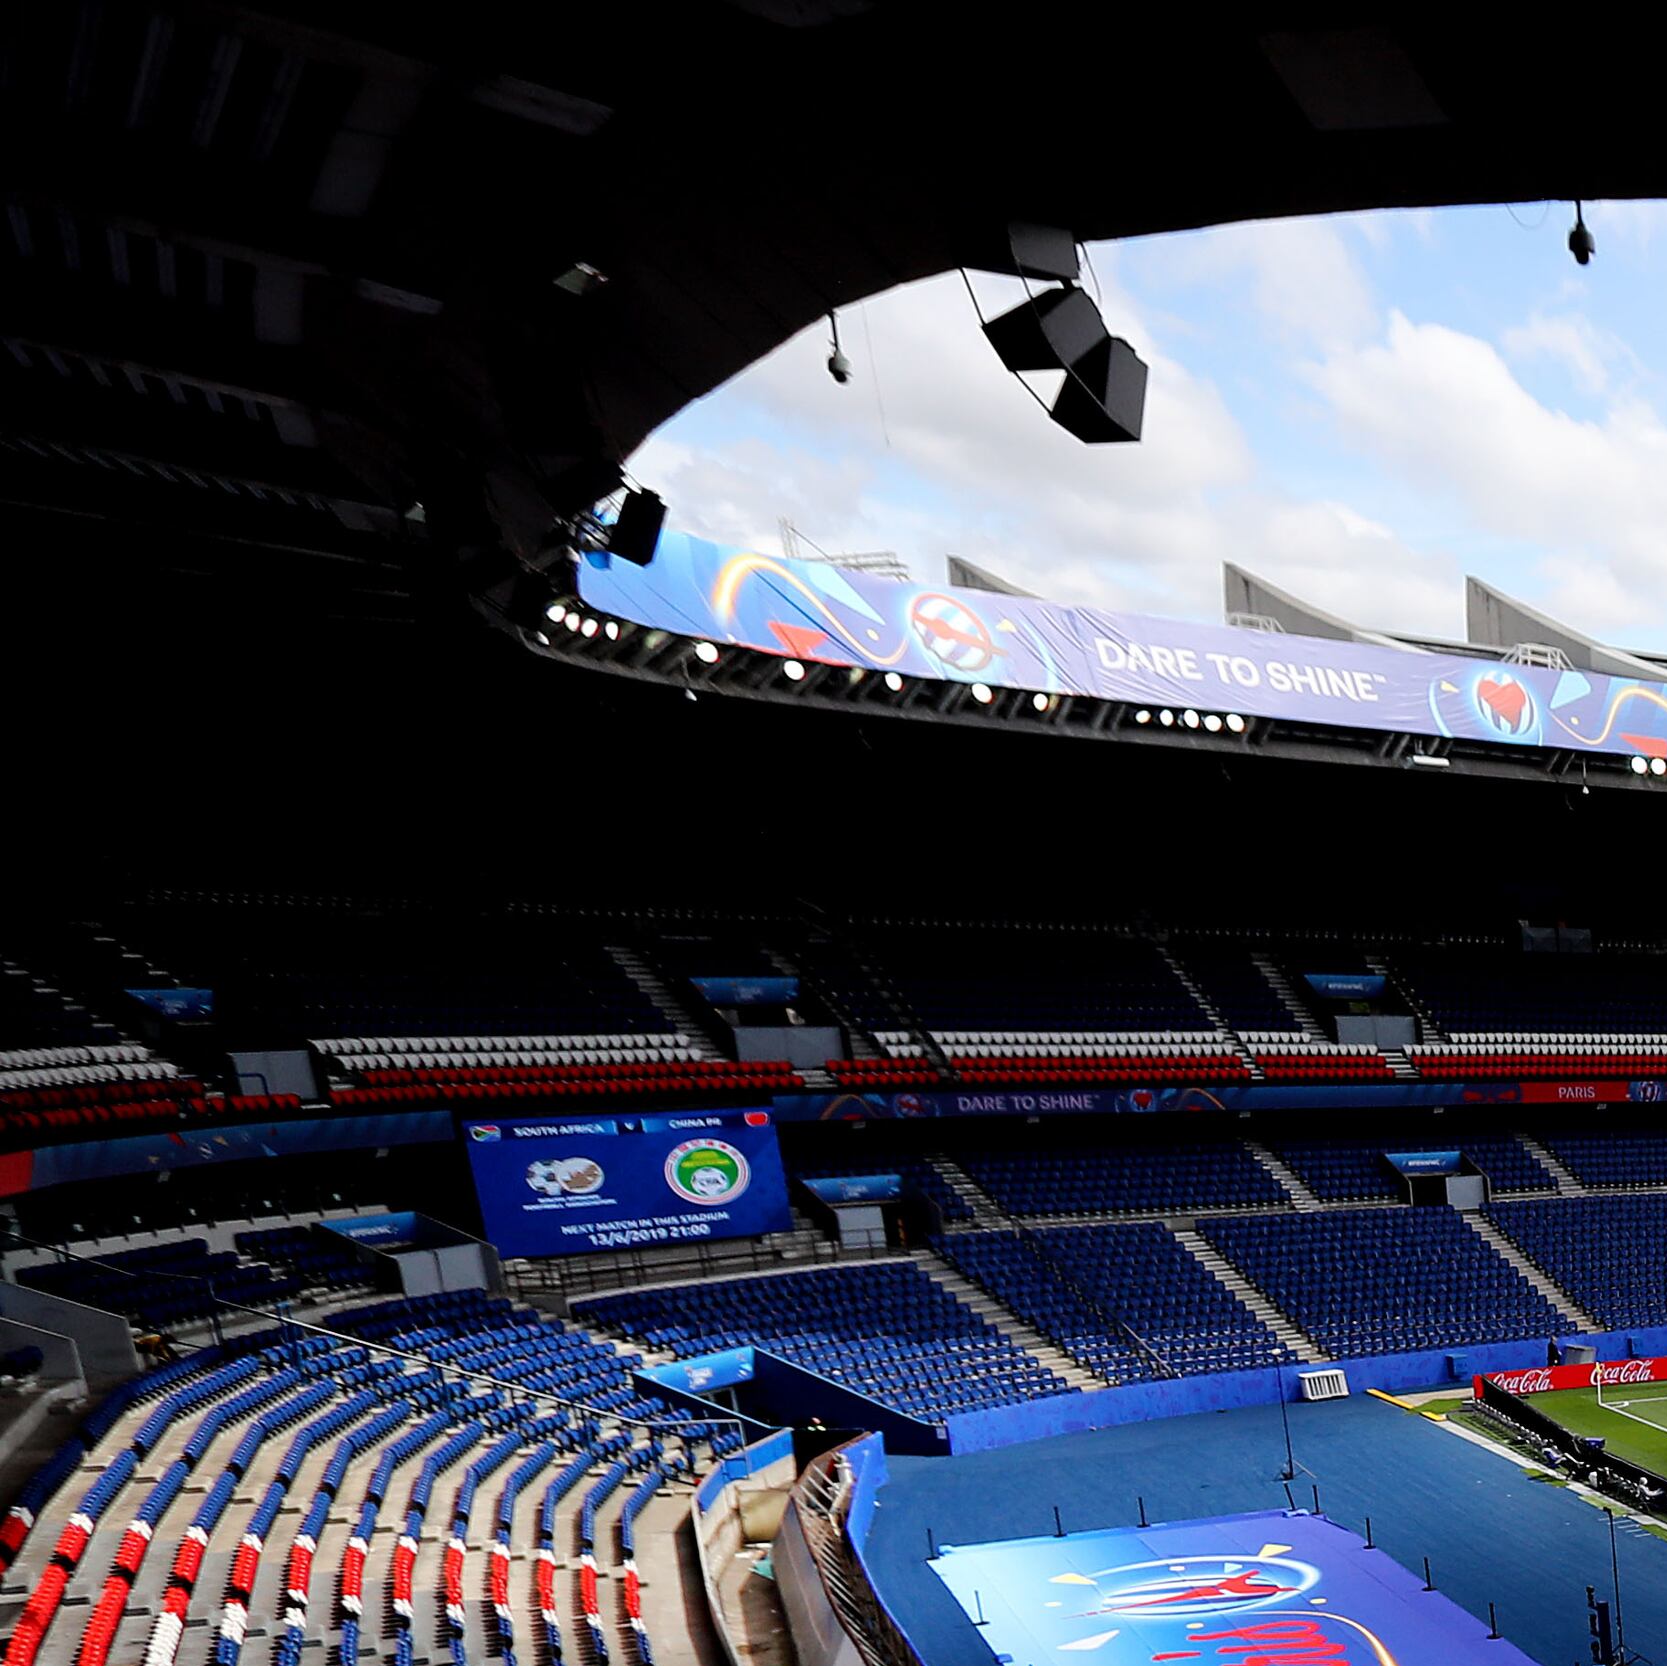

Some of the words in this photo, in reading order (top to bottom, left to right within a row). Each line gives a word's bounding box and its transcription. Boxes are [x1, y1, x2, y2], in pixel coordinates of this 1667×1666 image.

[1094, 637, 1204, 680] DARE
[1206, 652, 1261, 687] TO
[1557, 1086, 1595, 1099] PARIS
[956, 1095, 1008, 1112] DARE
[1009, 1095, 1037, 1111] TO
[513, 1126, 558, 1138] SOUTH
[559, 1122, 605, 1136] AFRICA
[668, 1118, 705, 1130] CHINA
[561, 1224, 594, 1236] NEXT
[596, 1219, 638, 1232] MATCH
[639, 1217, 652, 1229] IN
[653, 1216, 678, 1227] THIS
[679, 1211, 731, 1225] STADIUM
[670, 1223, 711, 1238] 21:00
